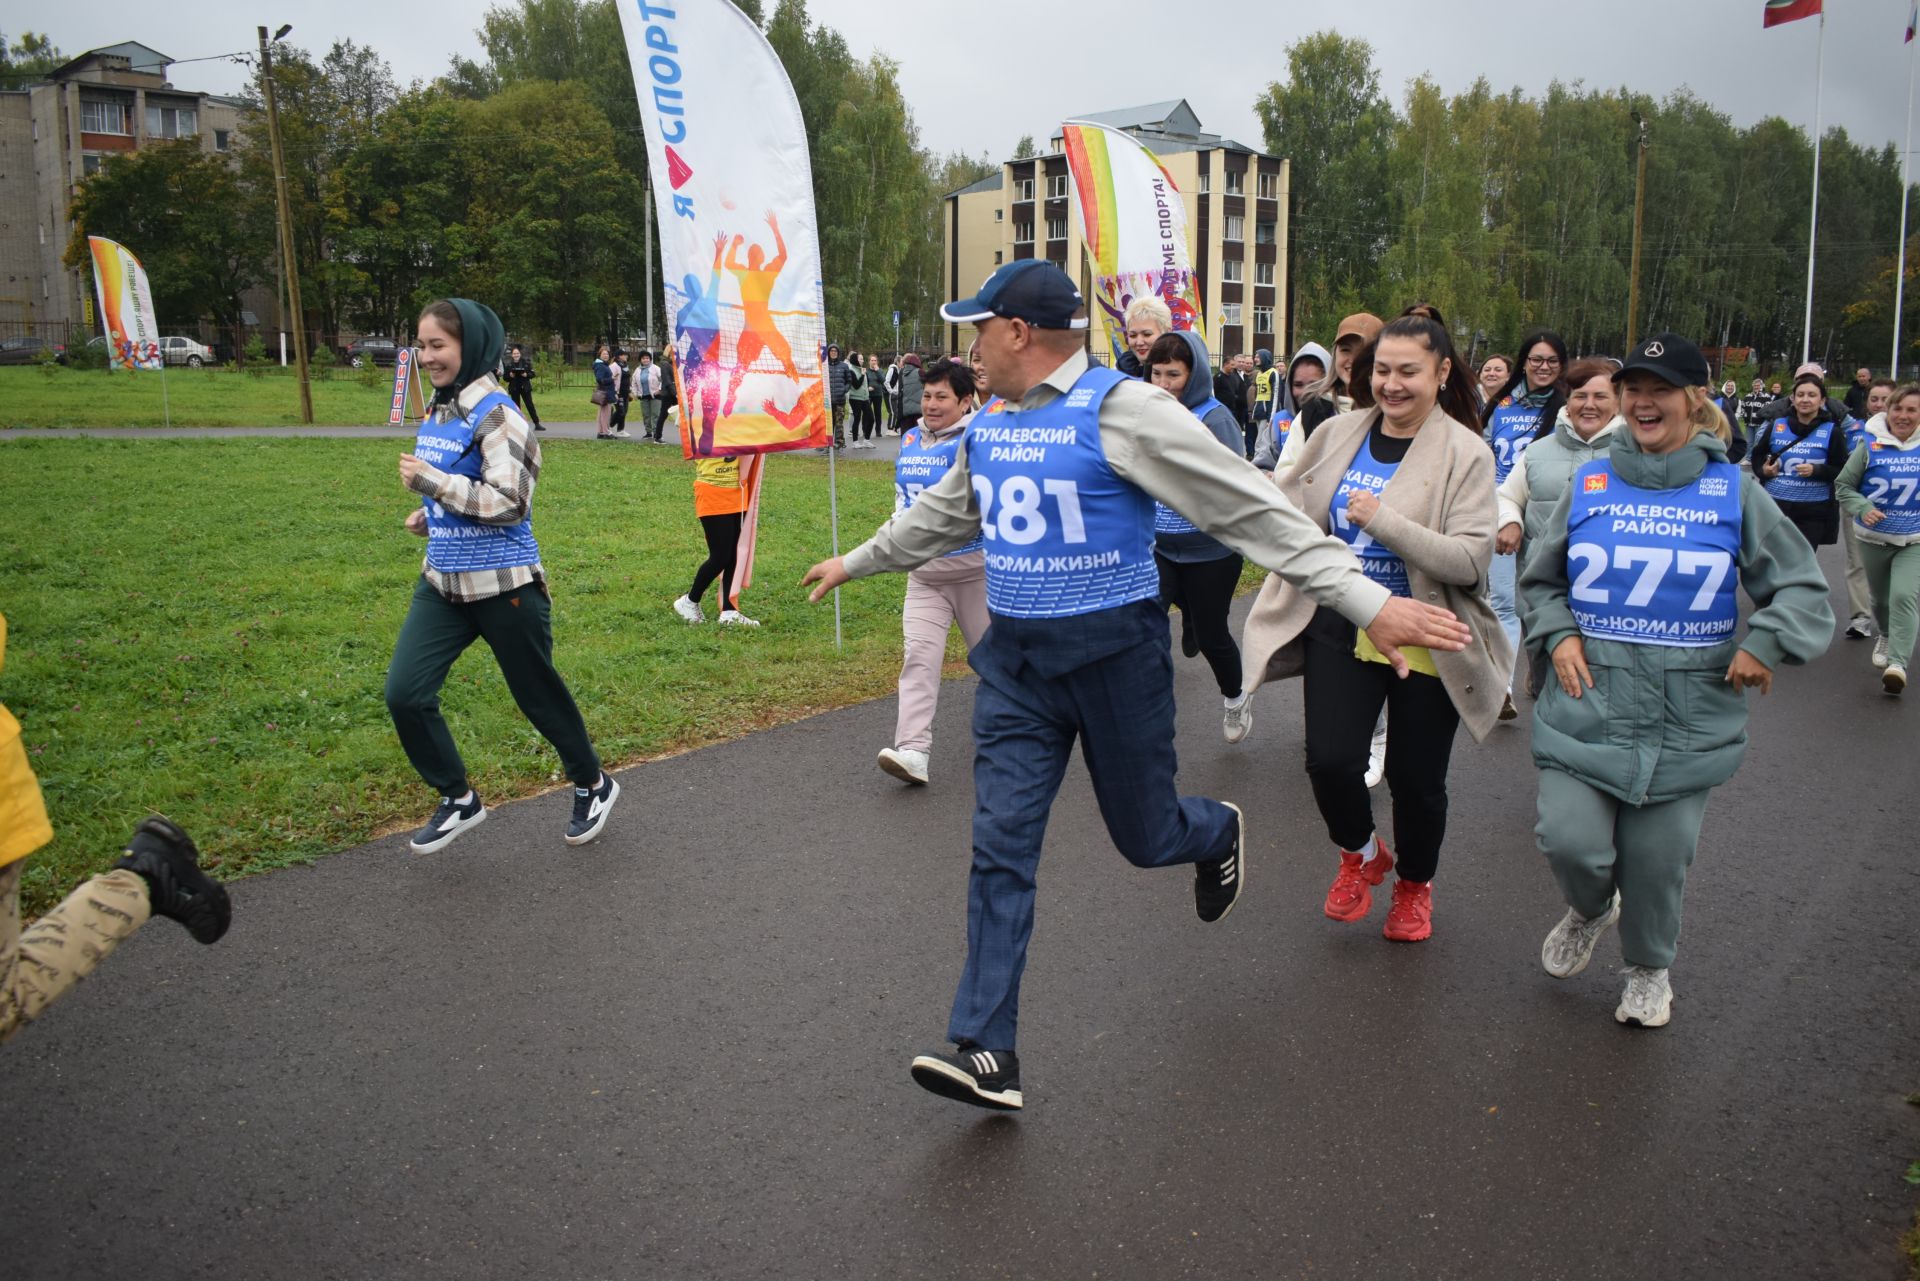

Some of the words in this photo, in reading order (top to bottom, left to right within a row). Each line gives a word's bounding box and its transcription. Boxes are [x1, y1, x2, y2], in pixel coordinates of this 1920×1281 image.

[637, 0, 687, 145] СПОРТ
[672, 193, 695, 222] Я
[1152, 178, 1173, 240] СПОРТА!
[390, 349, 409, 423] ФИНИШ
[973, 426, 1077, 445] ТУКАЕВСКИЙ
[415, 447, 443, 463] РАЙОН
[989, 443, 1046, 463] РАЙОН
[902, 465, 930, 476] РАЙОН
[1867, 477, 1920, 506] 27
[971, 474, 1087, 546] 281
[1587, 503, 1719, 525] ТУКАЕВСКИЙ
[1611, 518, 1686, 538] РАЙОН
[989, 555, 1046, 573] НОРМА
[1047, 549, 1121, 573] ЖИЗНИ
[1567, 542, 1731, 611] 277
[1610, 616, 1680, 635] НОРМА
[1682, 617, 1734, 635] ЖИЗНИ
